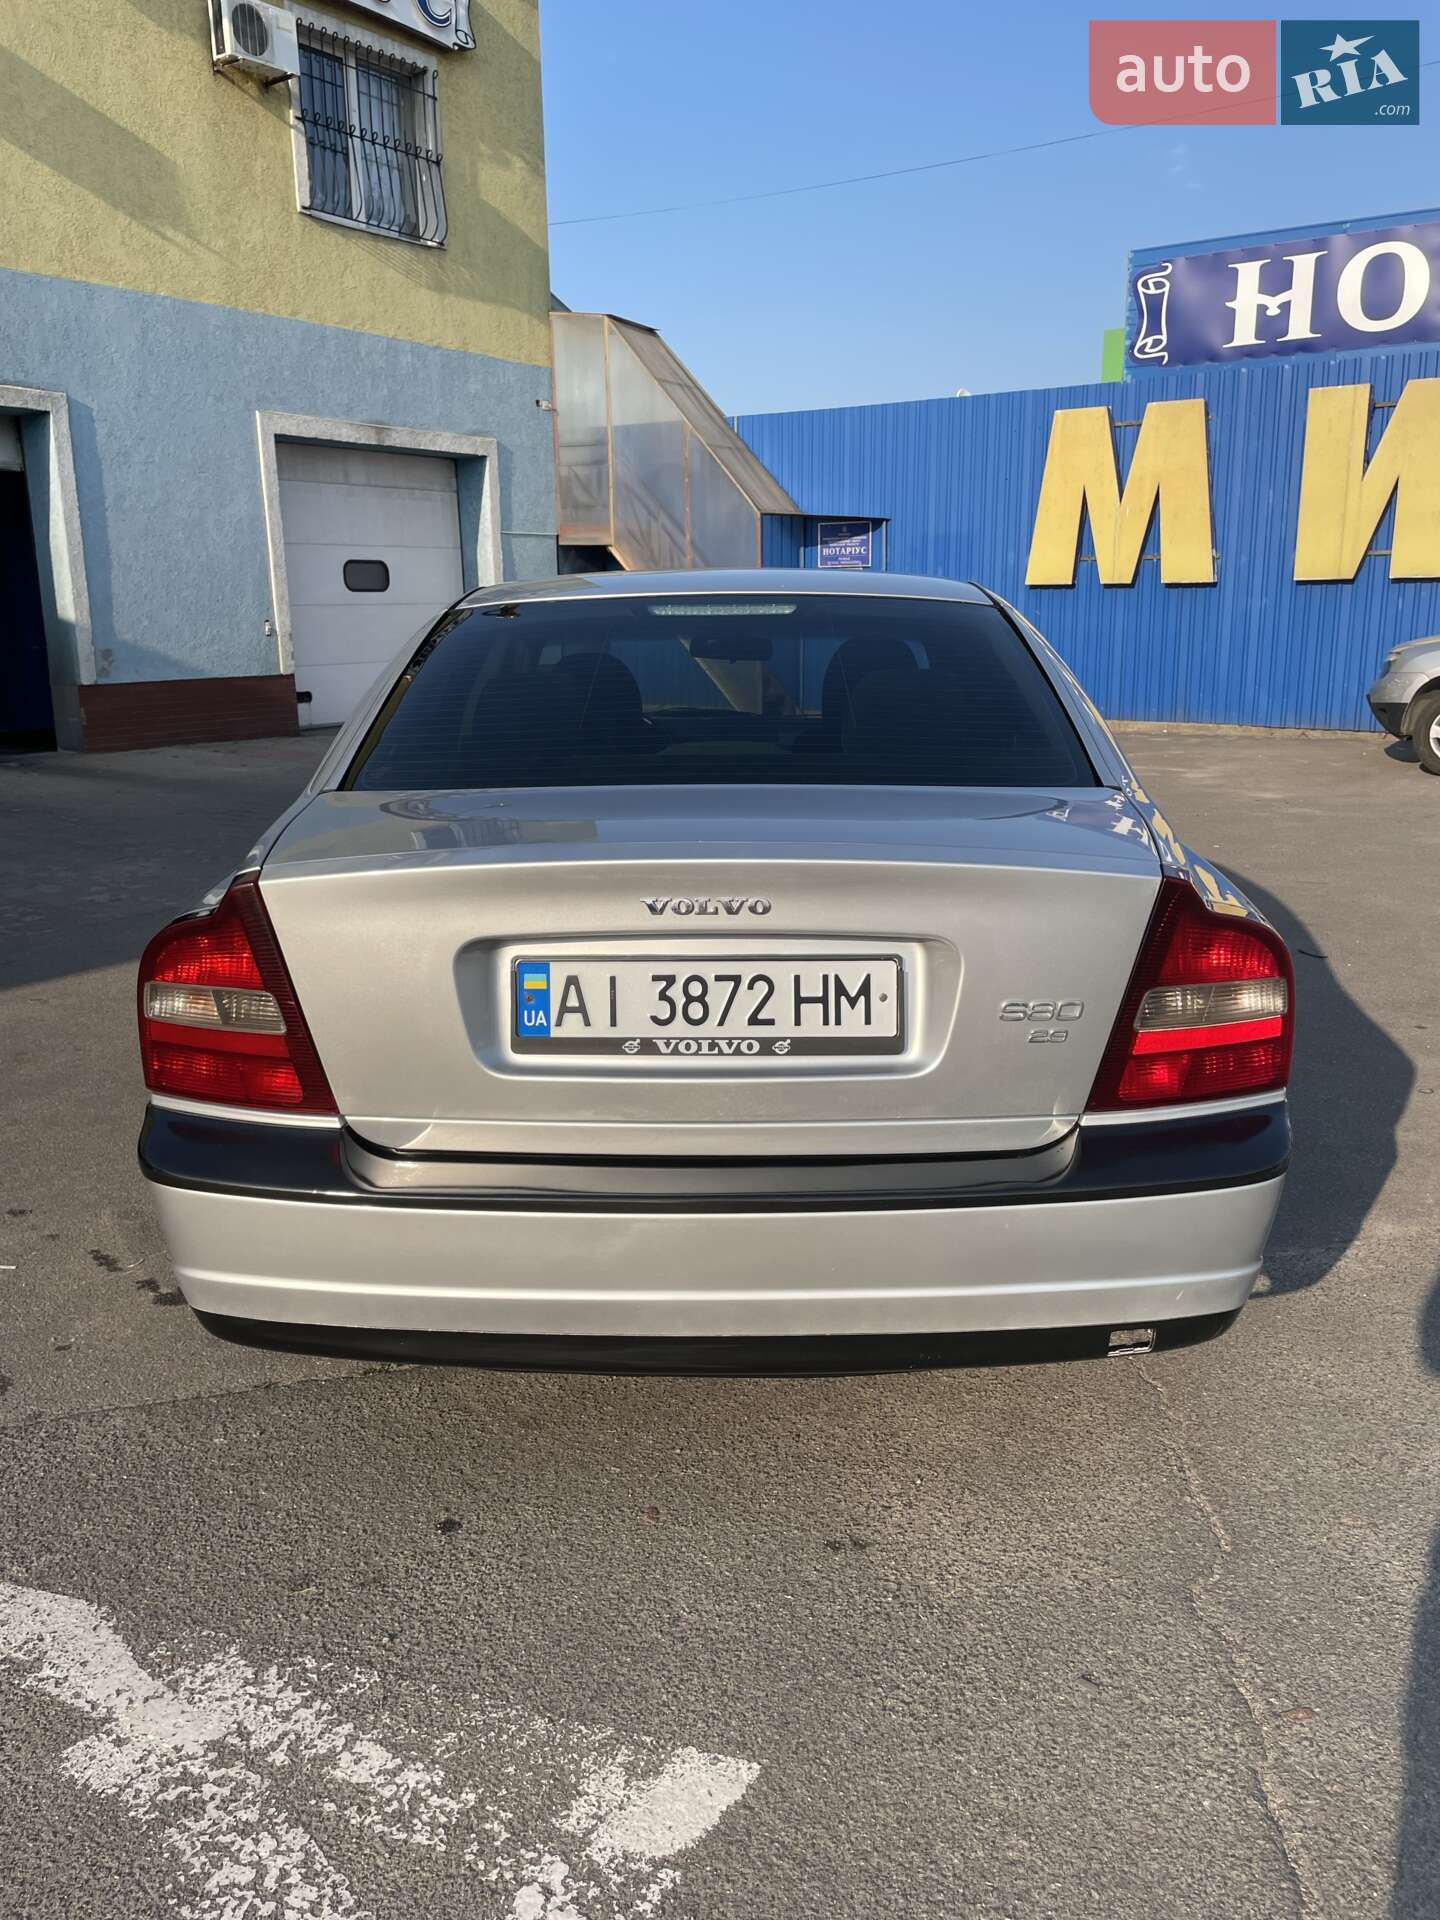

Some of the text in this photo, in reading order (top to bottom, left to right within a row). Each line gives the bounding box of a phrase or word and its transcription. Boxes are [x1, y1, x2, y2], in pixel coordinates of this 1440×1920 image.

[822, 546, 868, 556] НОТАРІУС
[640, 897, 772, 915] VOLVO
[649, 974, 776, 1027] 3872
[793, 973, 872, 1027] HM
[523, 1011, 547, 1027] UA
[1000, 1000, 1085, 1021] S80
[652, 1039, 761, 1055] VOLVO
